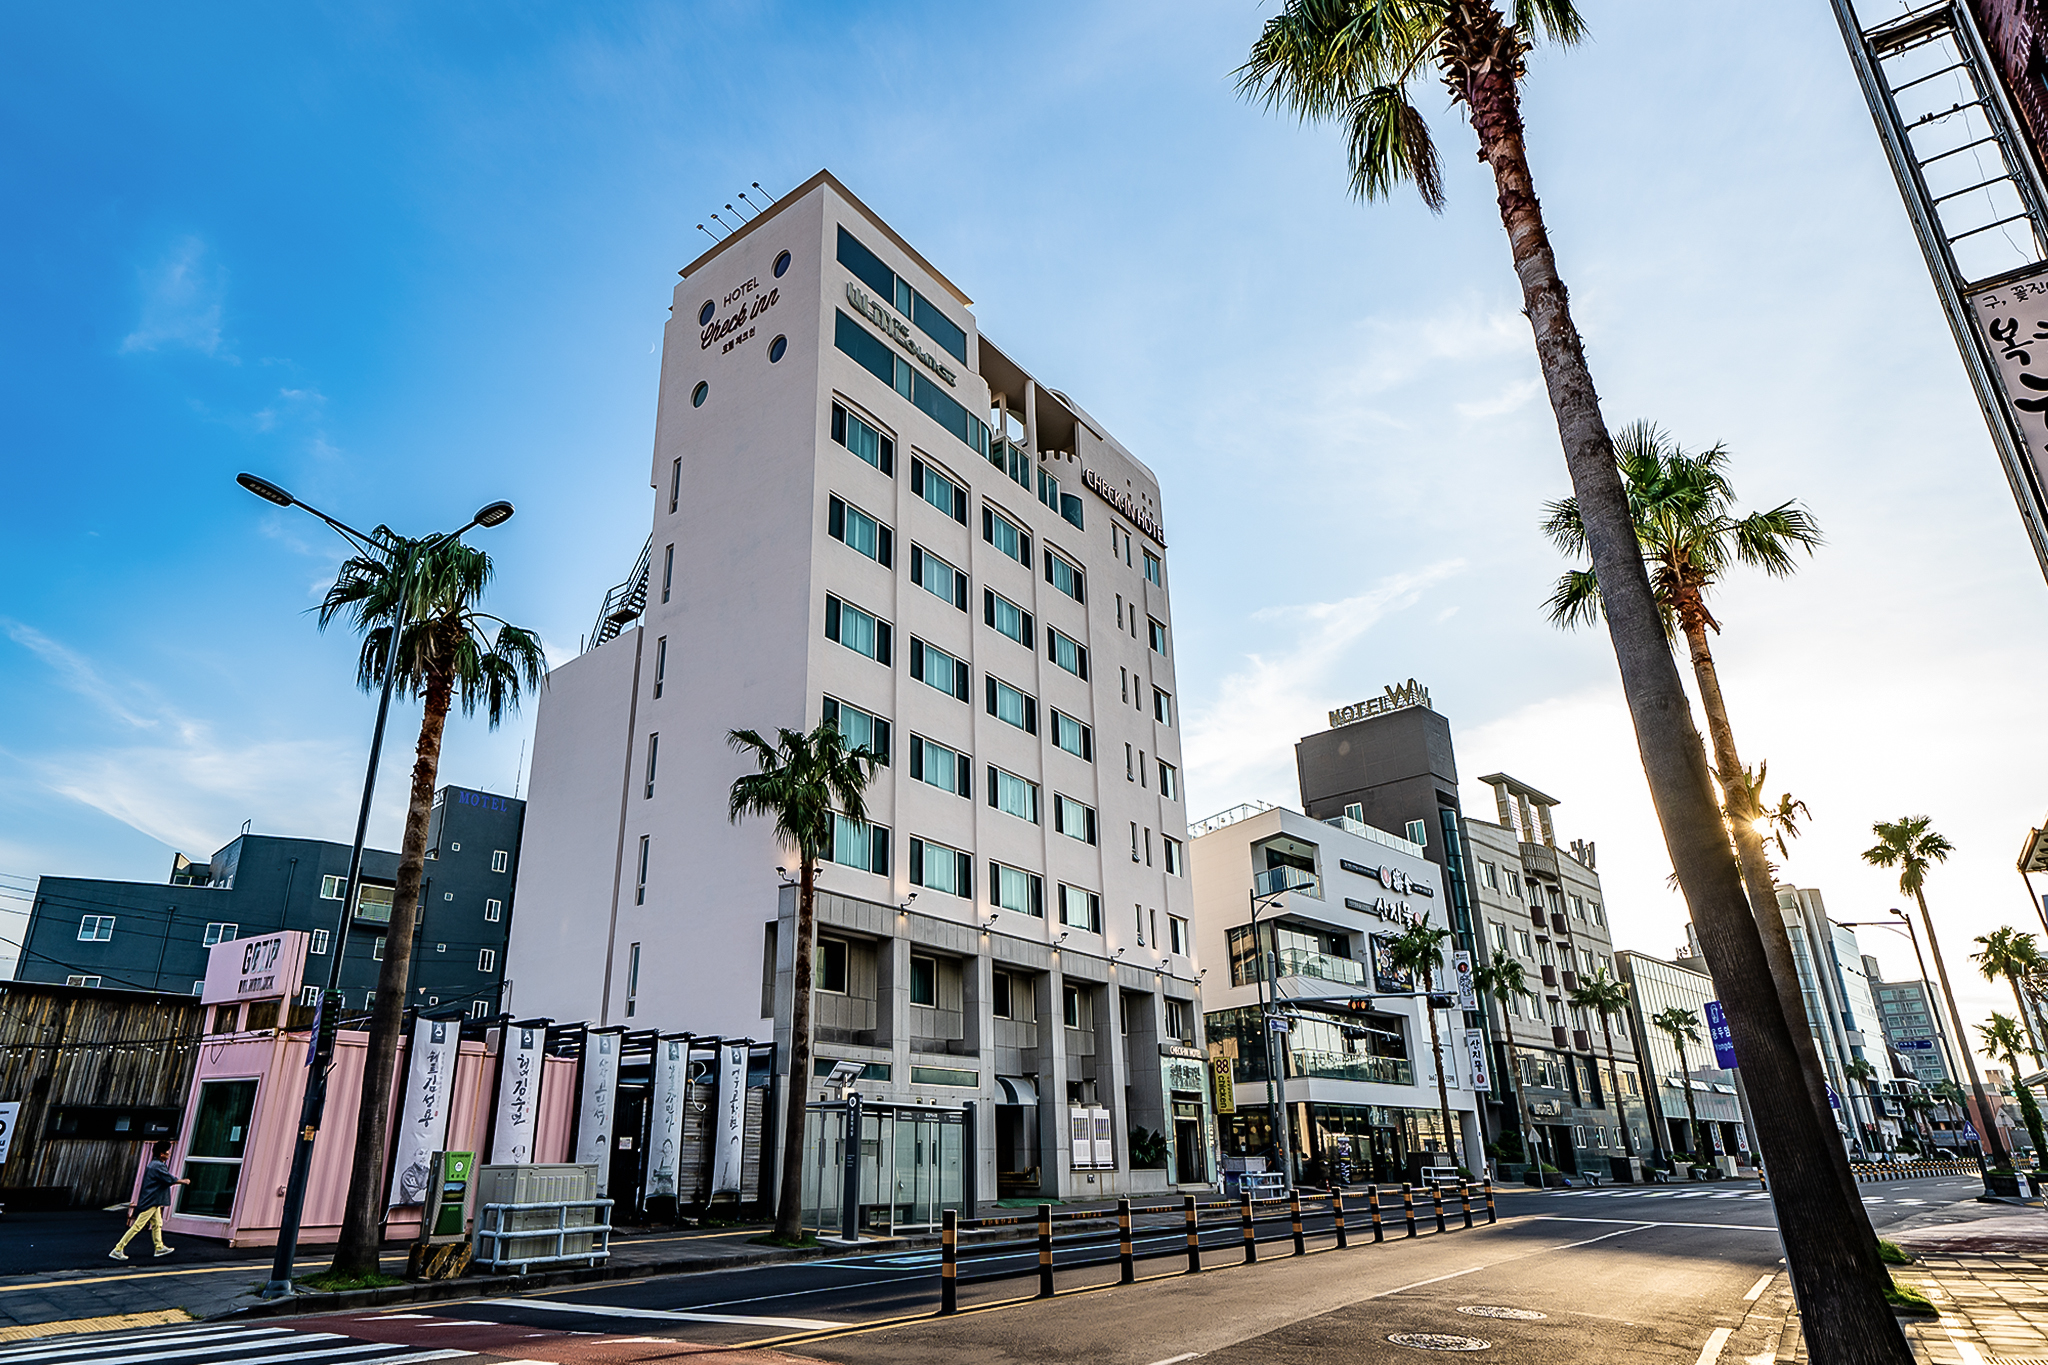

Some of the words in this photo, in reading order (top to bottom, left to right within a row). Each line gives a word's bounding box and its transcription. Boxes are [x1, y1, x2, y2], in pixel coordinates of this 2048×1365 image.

[723, 276, 759, 308] HOTEL
[701, 302, 747, 350] Check
[749, 287, 781, 320] inn
[1086, 468, 1136, 521] CHECK-IN
[1137, 508, 1168, 547] HOTEL
[1384, 677, 1415, 709] W
[459, 791, 507, 812] MOTEL
[1216, 1059, 1229, 1074] 88
[1470, 1039, 1482, 1073] 산지물
[1218, 1075, 1227, 1109] chicken
